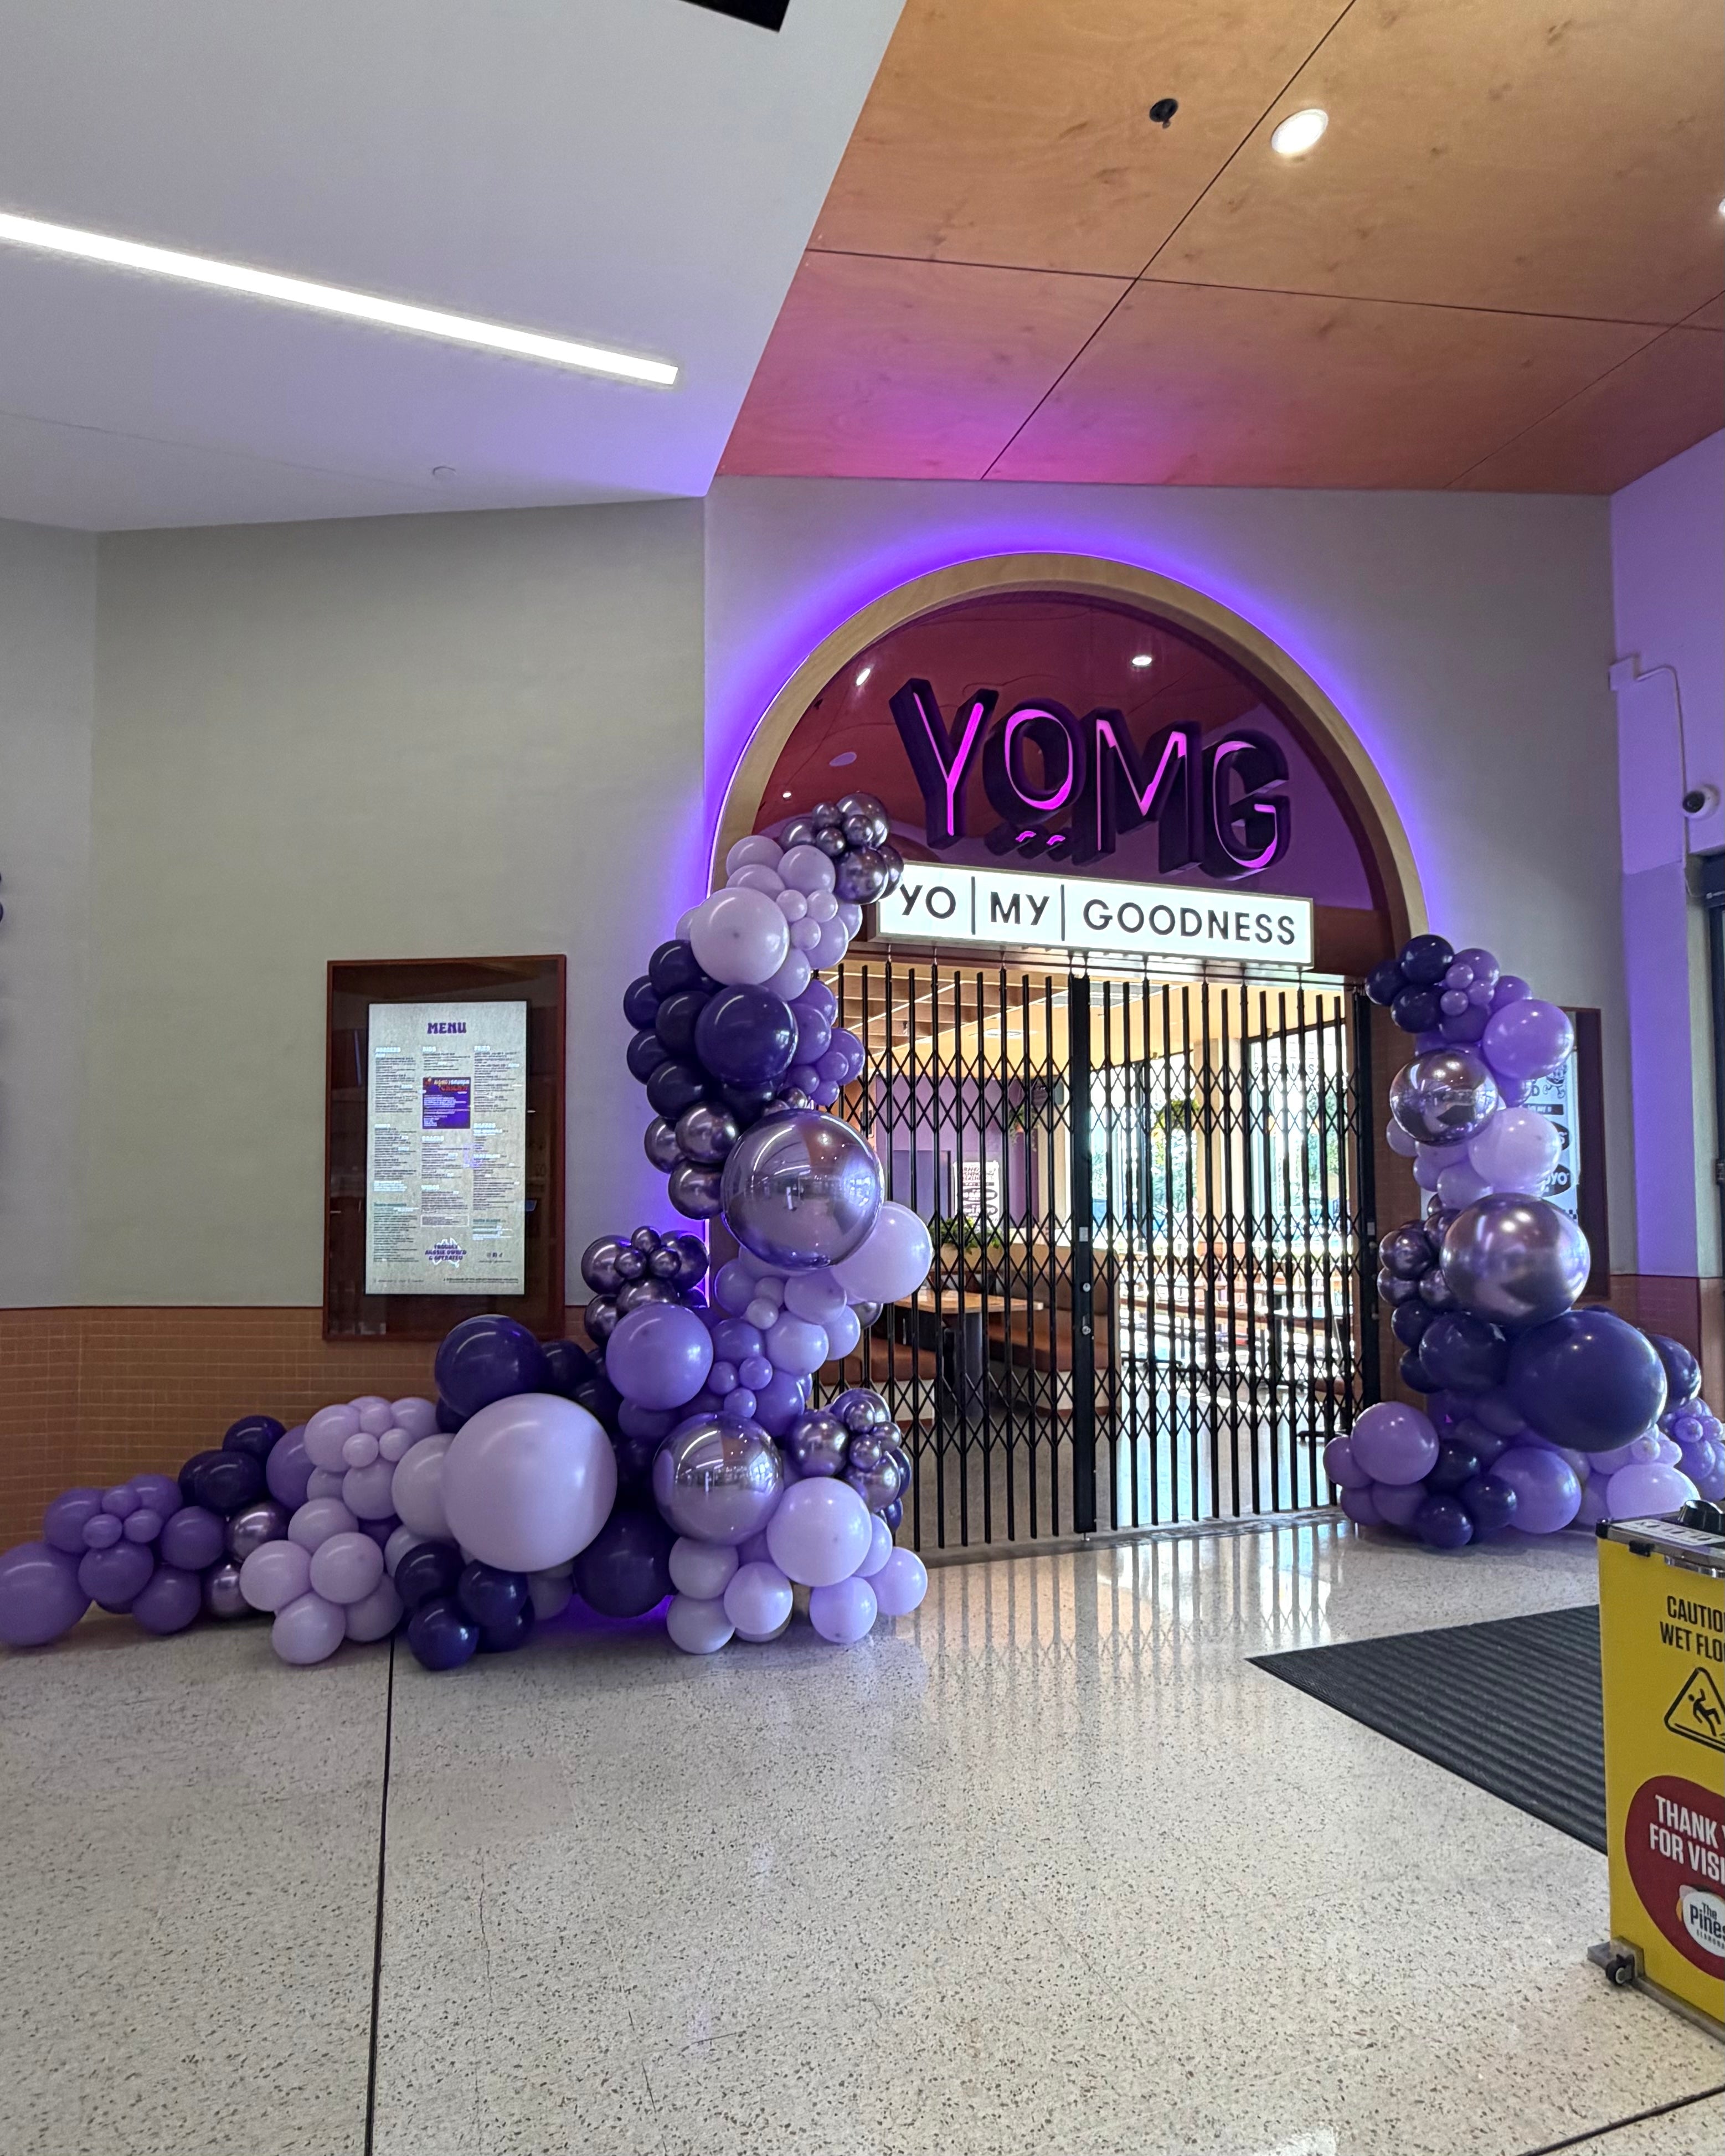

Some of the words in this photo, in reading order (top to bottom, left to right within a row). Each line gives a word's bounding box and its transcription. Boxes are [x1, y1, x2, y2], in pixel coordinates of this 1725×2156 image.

[889, 679, 1289, 880] YOMG
[900, 884, 956, 919] YO
[991, 891, 1049, 925] MY
[1083, 899, 1295, 945] GOODNESS
[427, 1022, 467, 1034] MENU
[1667, 1595, 1725, 1633] CAUTIO
[1660, 1621, 1692, 1652] WET
[1696, 1633, 1725, 1663] FLO
[1655, 1794, 1718, 1849] THANK
[1649, 1822, 1684, 1864] FOR
[1702, 1902, 1717, 1920] The
